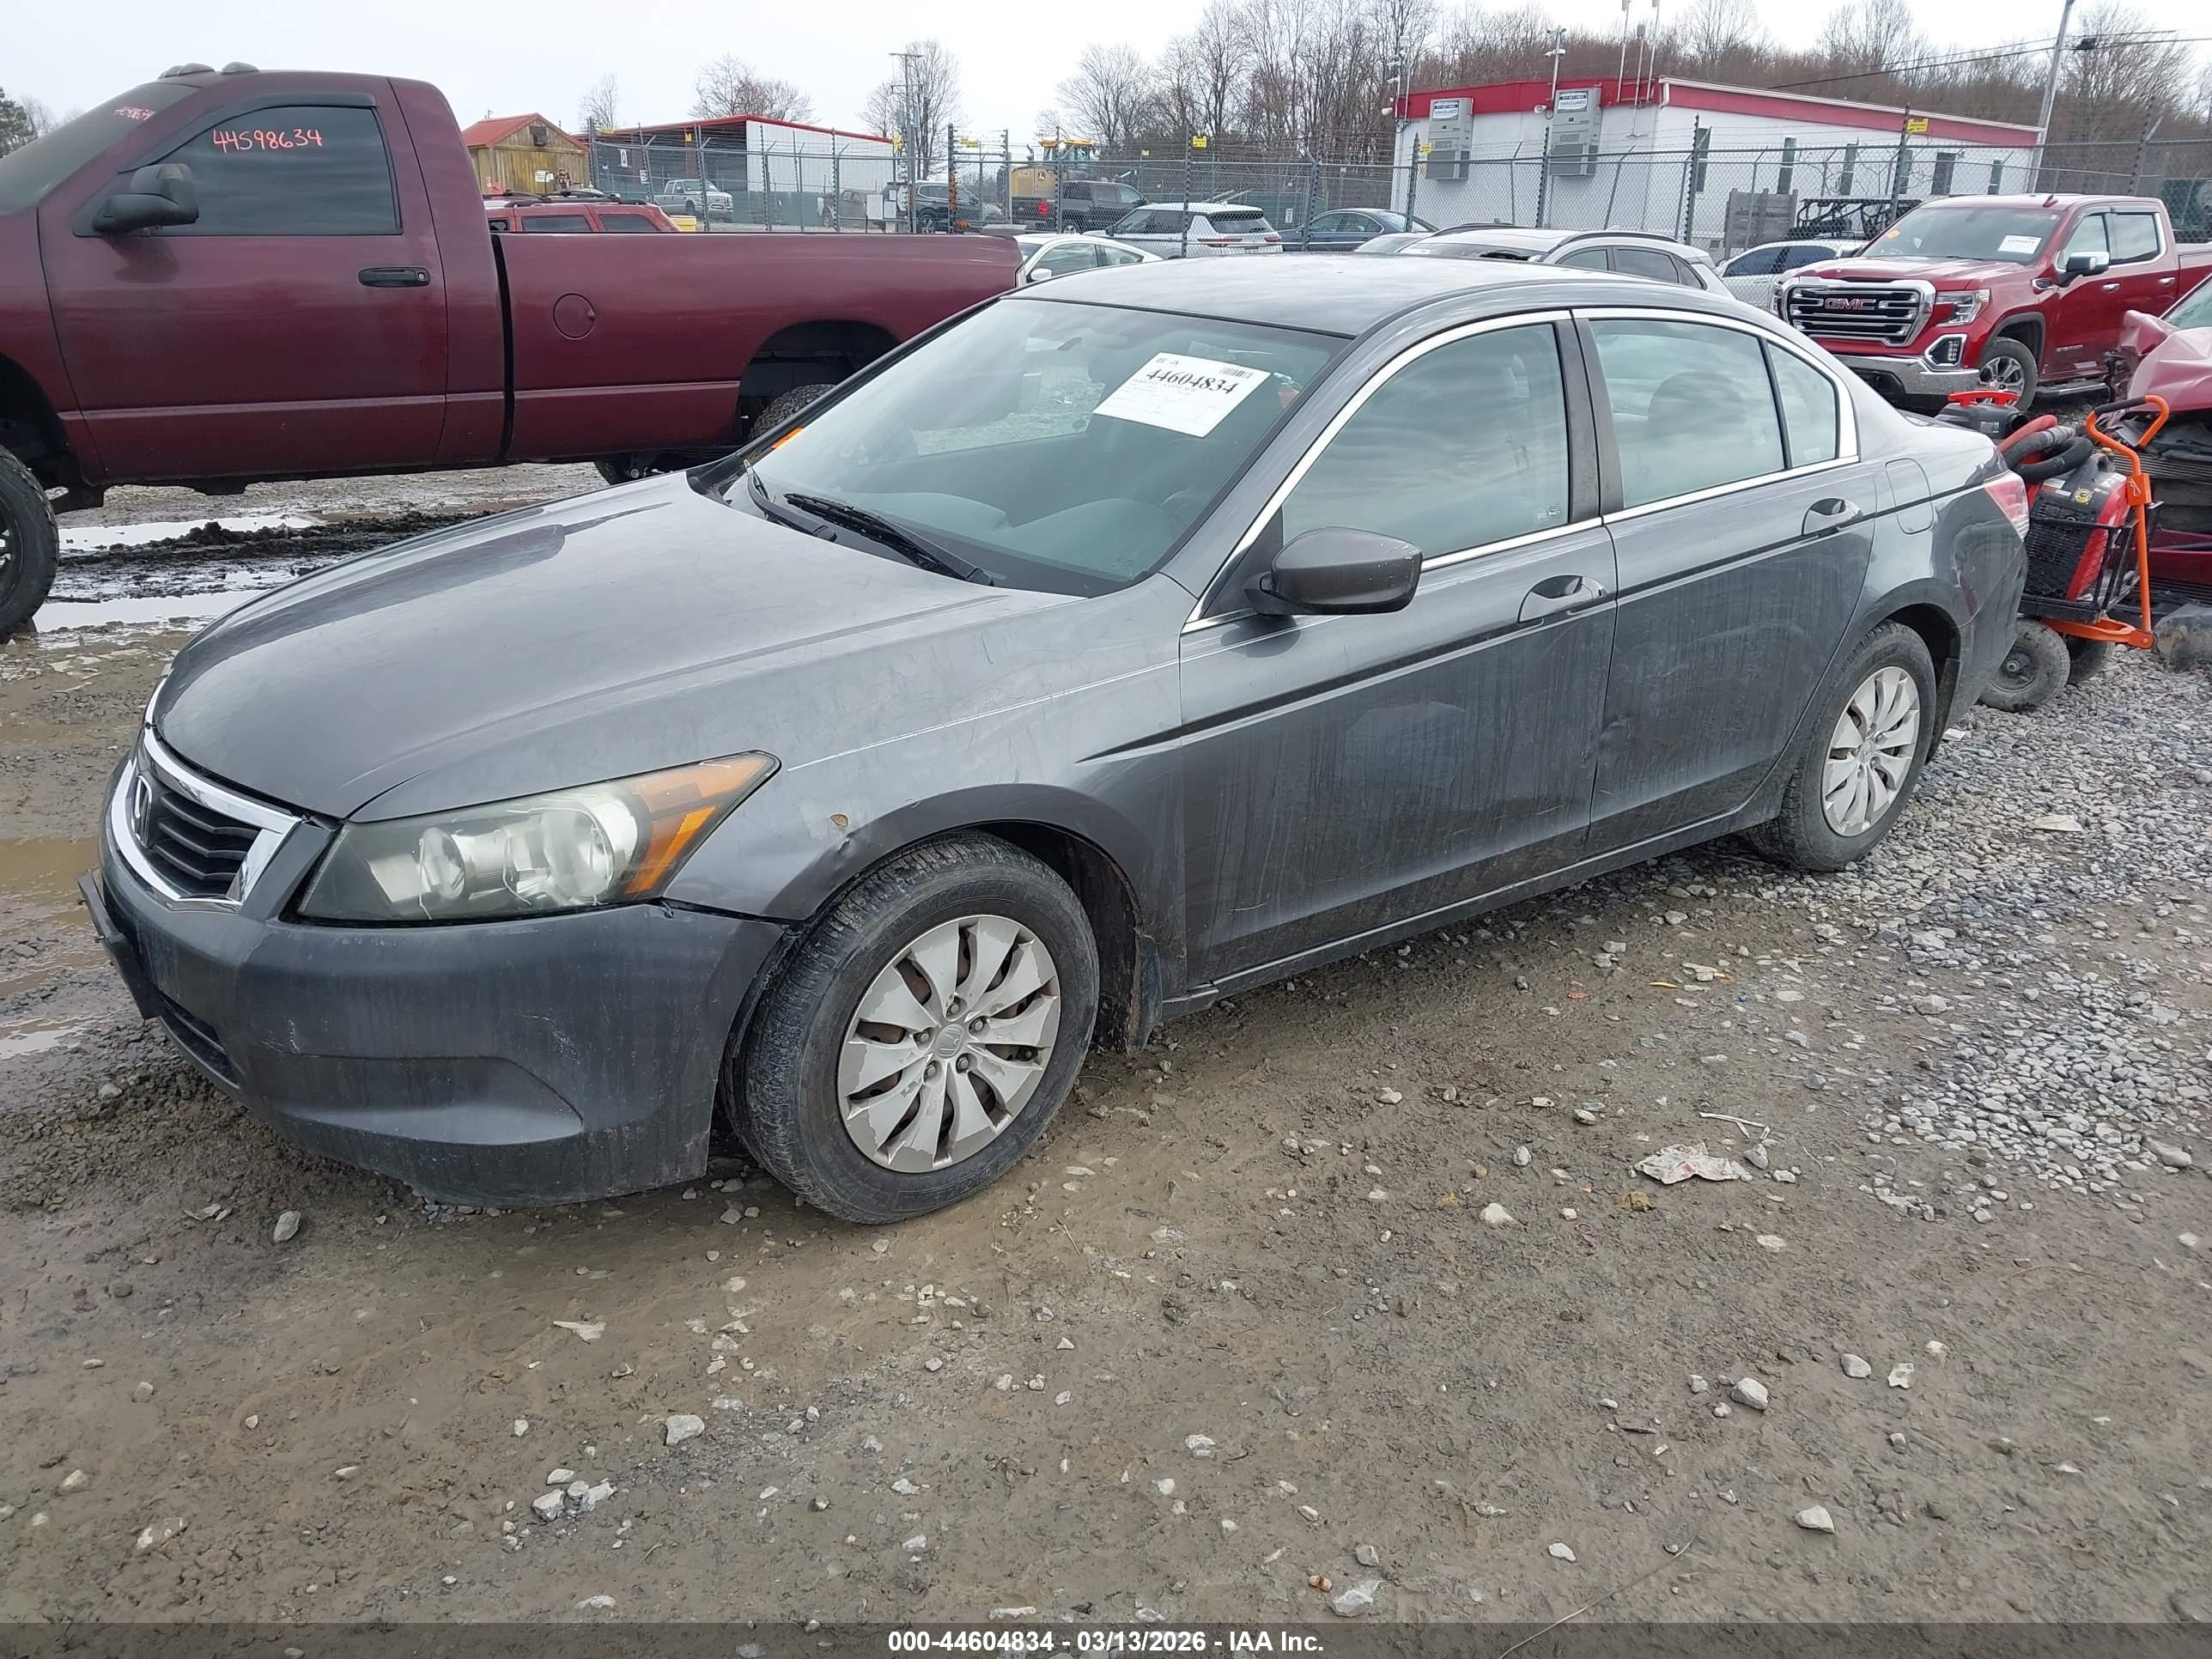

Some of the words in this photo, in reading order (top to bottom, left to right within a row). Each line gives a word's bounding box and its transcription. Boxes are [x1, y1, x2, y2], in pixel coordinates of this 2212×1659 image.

[213, 129, 323, 154] 44598634
[1825, 297, 1877, 311] GMC
[1146, 368, 1239, 394] 44604834
